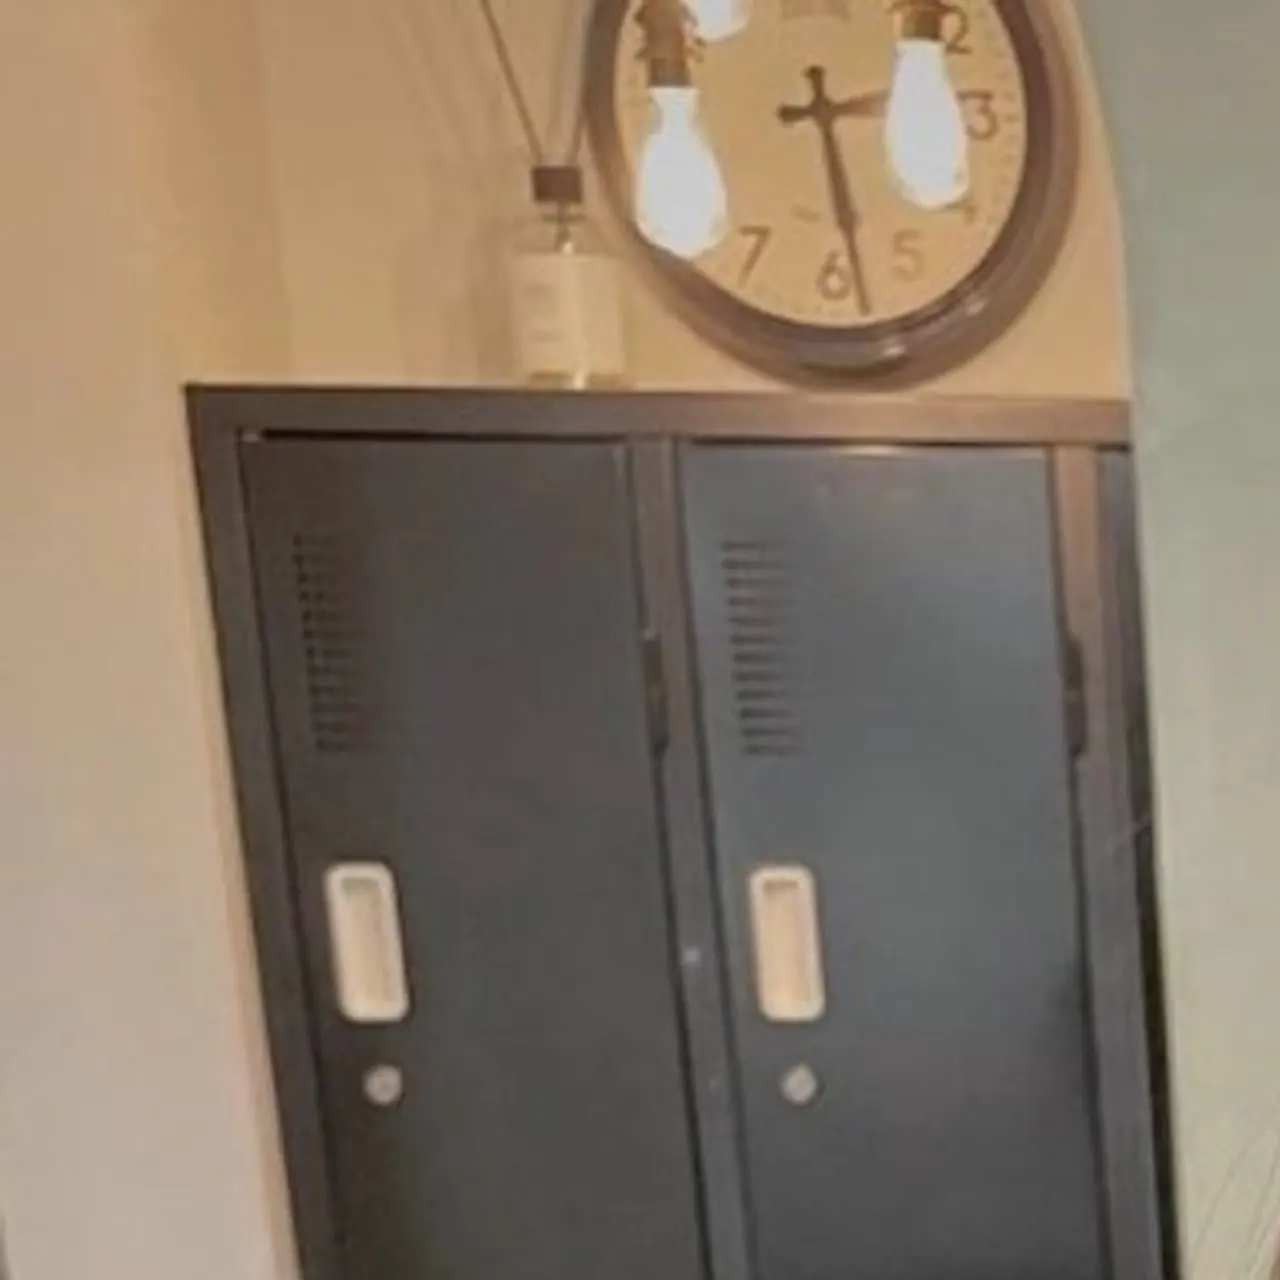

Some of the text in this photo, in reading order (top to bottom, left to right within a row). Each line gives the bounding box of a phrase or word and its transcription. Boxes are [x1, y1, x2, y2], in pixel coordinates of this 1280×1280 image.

[943, 5, 972, 54] 2
[956, 88, 998, 140] 3
[736, 225, 771, 288] 7
[816, 250, 852, 302] 6
[892, 228, 924, 282] 5
